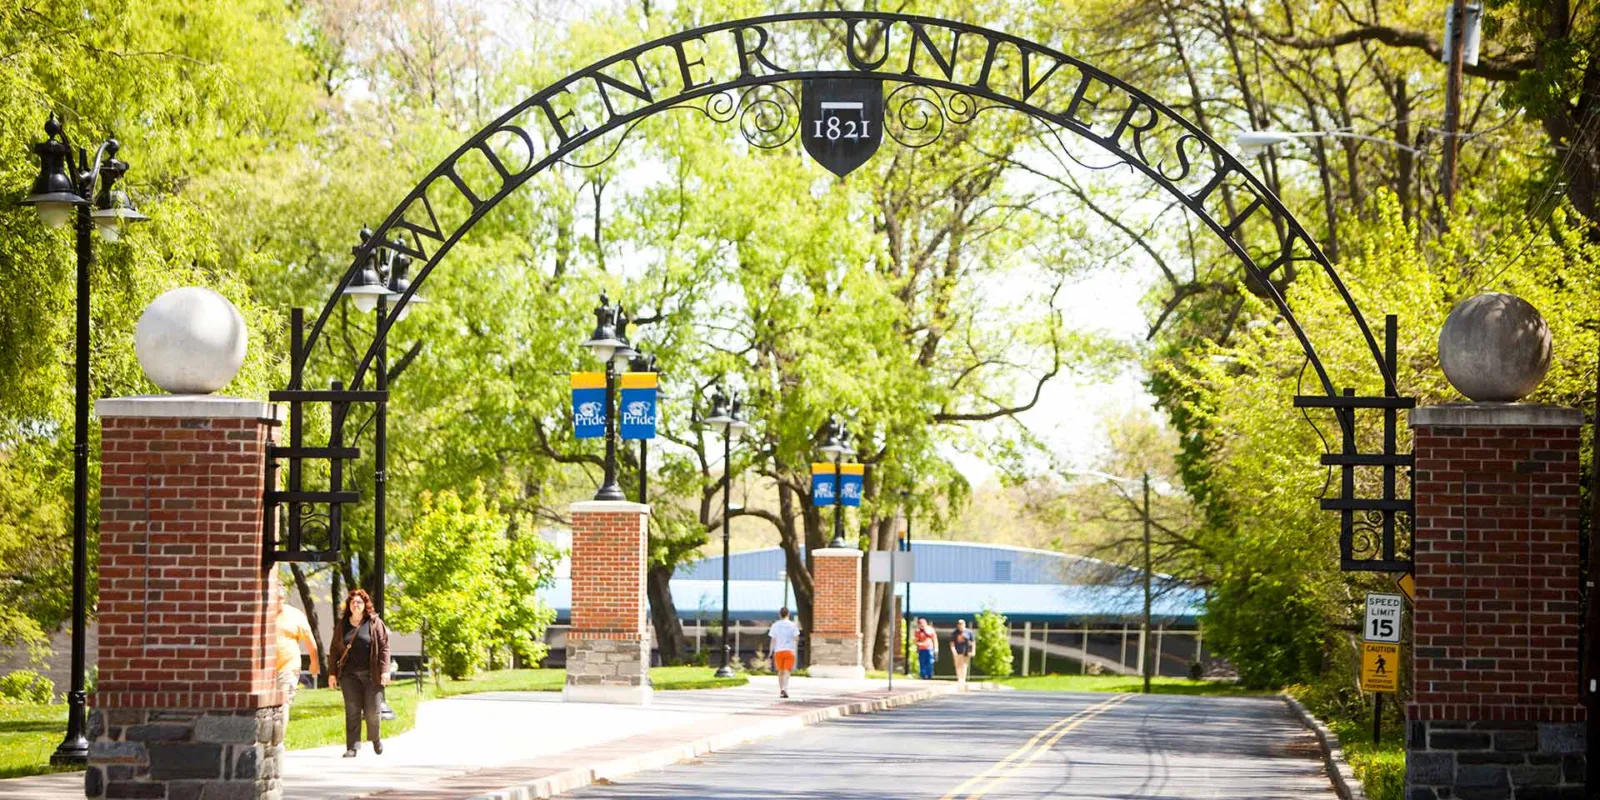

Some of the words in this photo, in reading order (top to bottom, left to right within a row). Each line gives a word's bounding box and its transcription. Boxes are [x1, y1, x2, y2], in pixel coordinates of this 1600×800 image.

[813, 116, 870, 140] 1821
[376, 24, 789, 262] WIDENER
[845, 17, 1325, 279] UNIVERSITY
[575, 413, 606, 426] Pride
[623, 412, 654, 425] Pride
[1369, 597, 1399, 607] SPEED
[1372, 619, 1393, 637] 15
[1366, 645, 1396, 653] CAUTION
